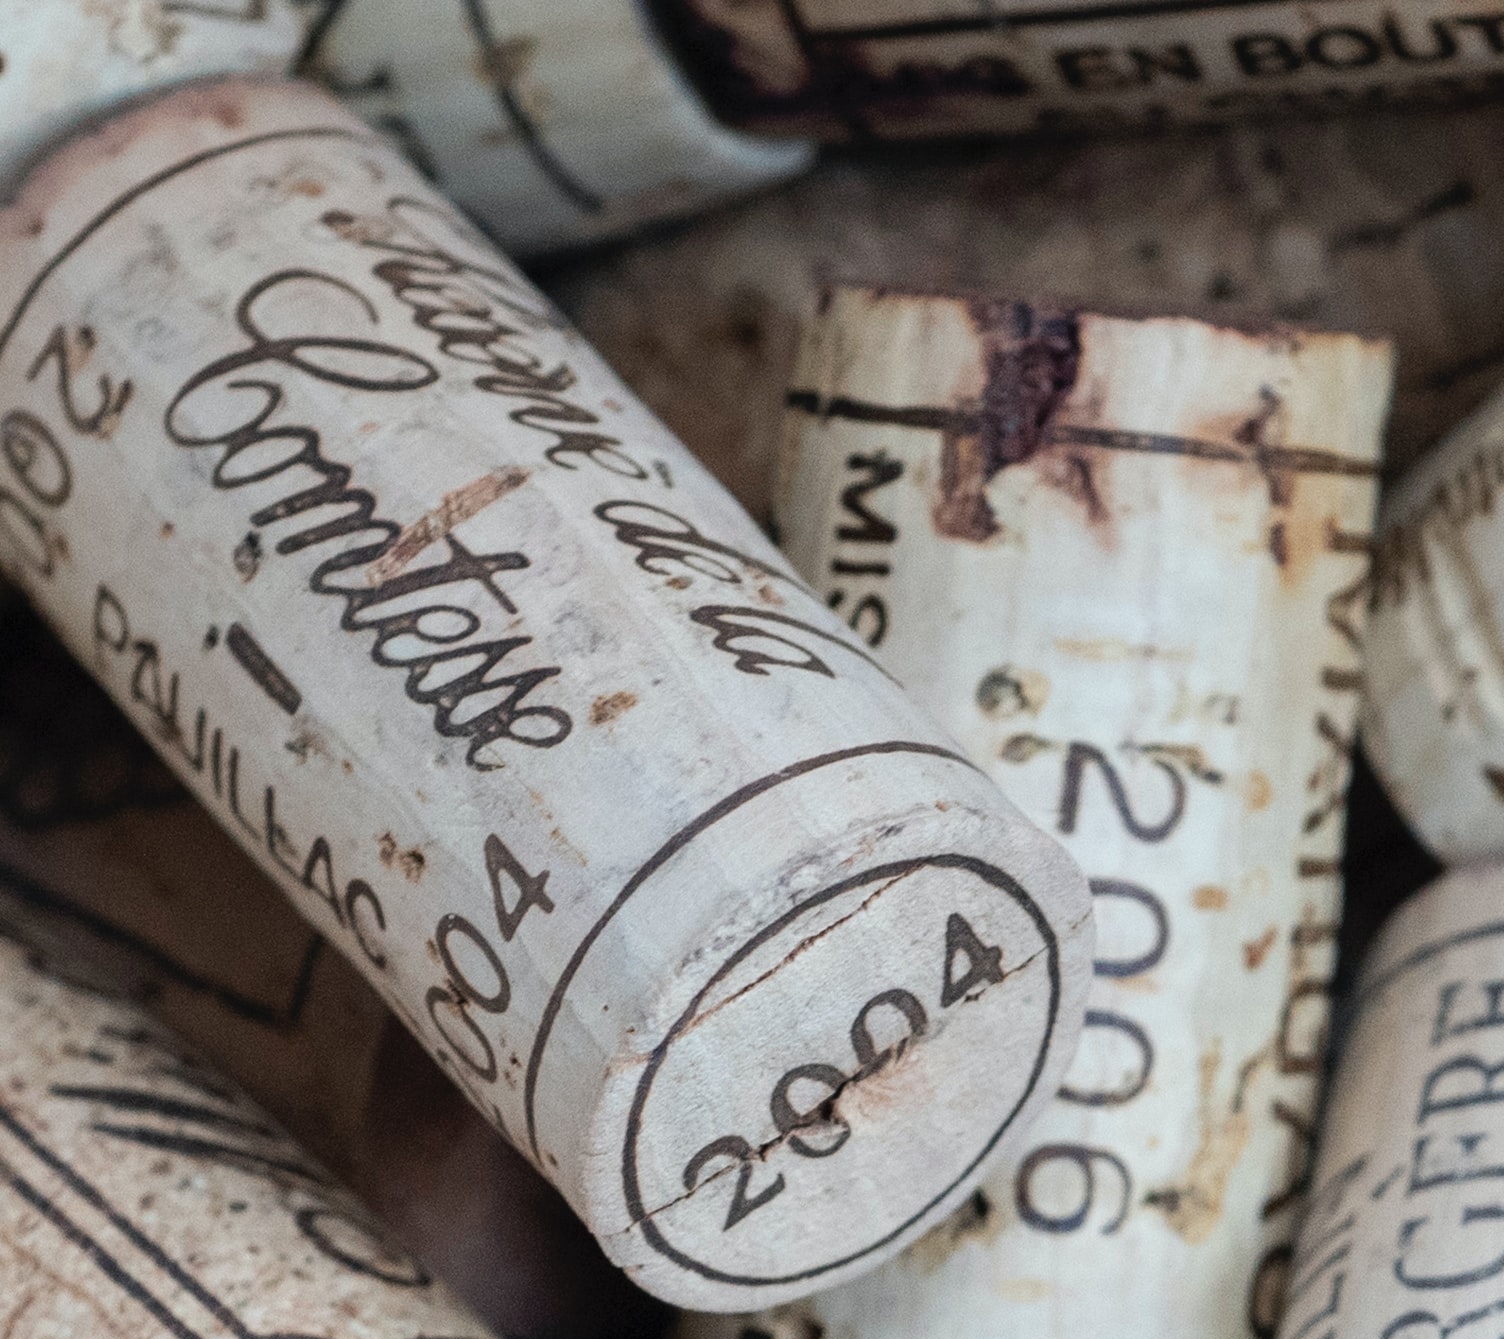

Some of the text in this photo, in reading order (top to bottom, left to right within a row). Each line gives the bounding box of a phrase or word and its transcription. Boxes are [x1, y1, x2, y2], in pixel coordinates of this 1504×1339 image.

[163, 268, 574, 775] Comtesse
[824, 448, 906, 650] MIS
[682, 910, 1009, 1235] 2004
[1011, 740, 1188, 1238] 2006
